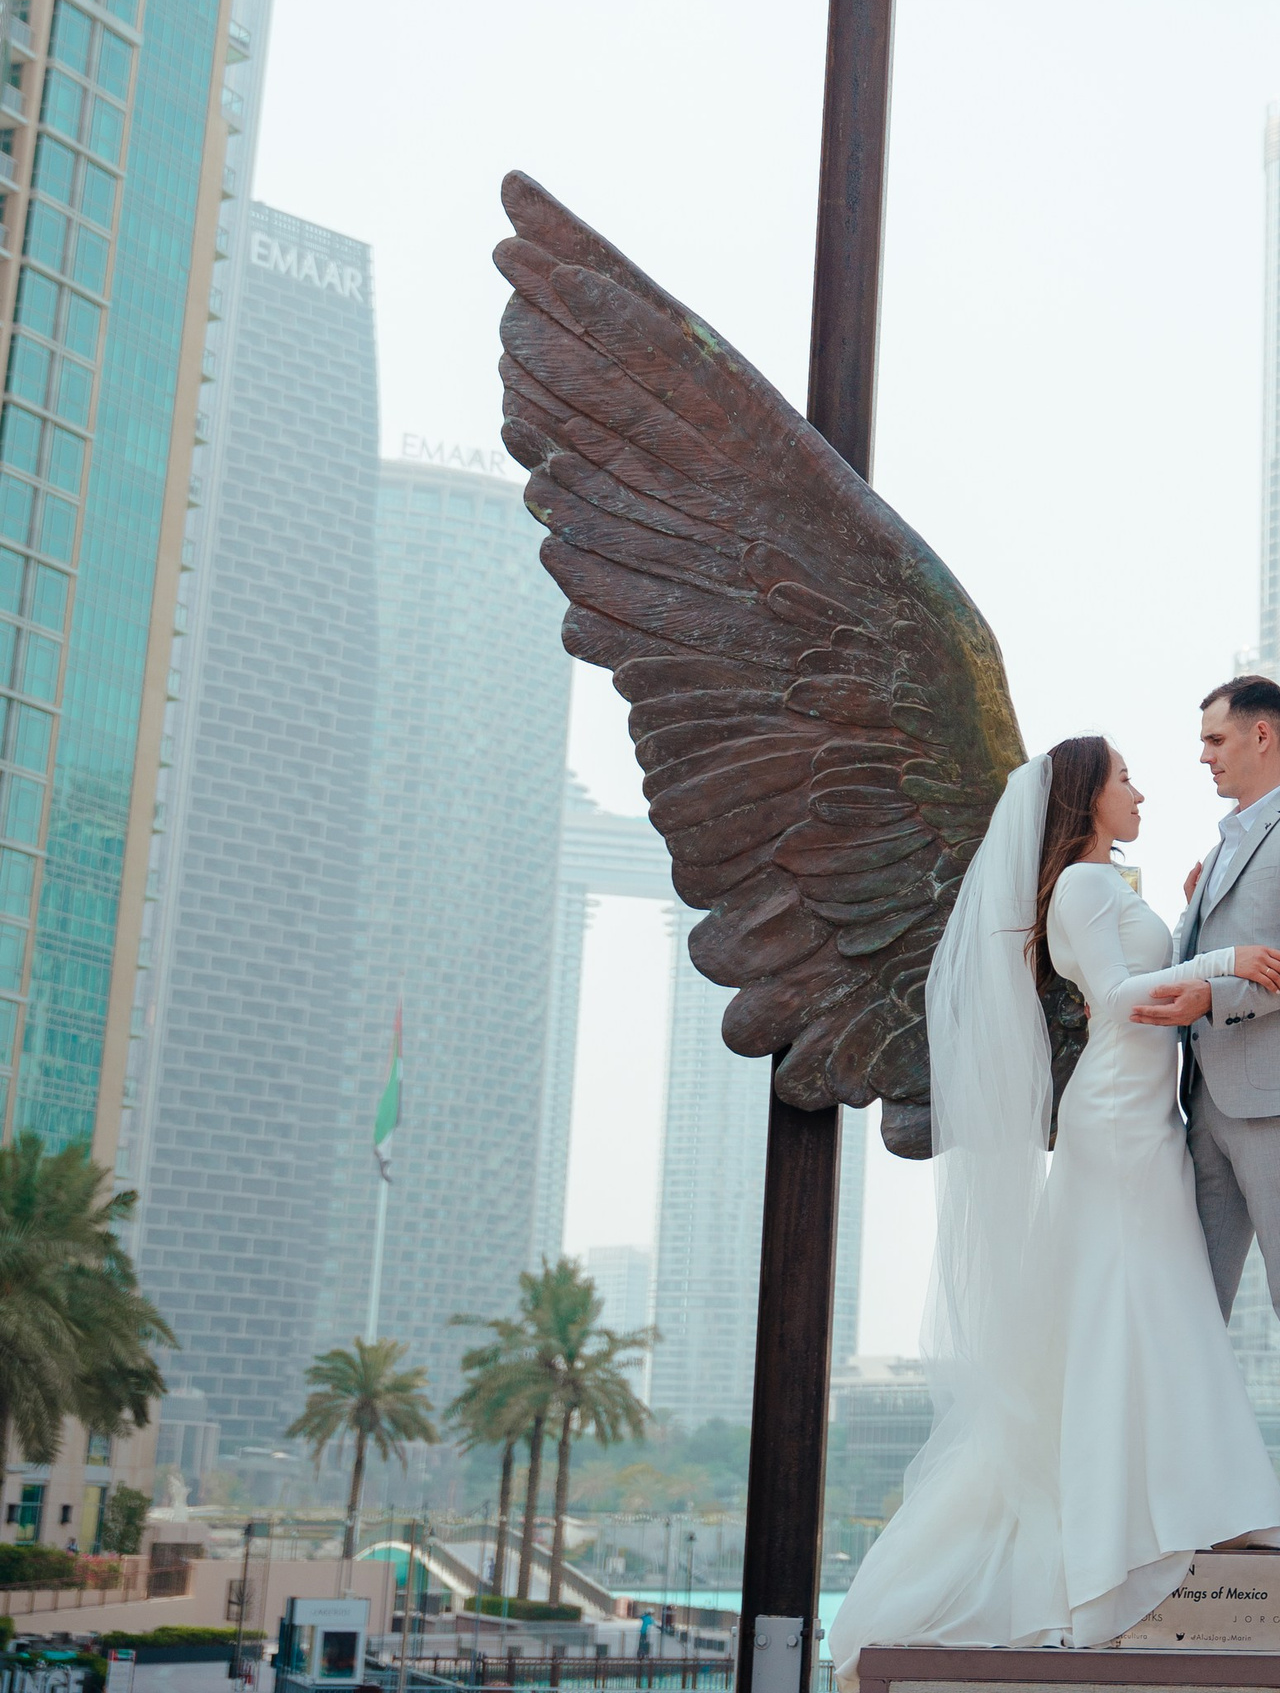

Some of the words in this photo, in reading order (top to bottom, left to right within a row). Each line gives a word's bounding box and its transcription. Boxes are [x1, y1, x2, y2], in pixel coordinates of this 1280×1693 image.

[251, 234, 364, 303] EMAAR
[402, 432, 506, 476] EMAAR
[1171, 1587, 1207, 1603] Wings
[1211, 1586, 1224, 1599] of
[1226, 1587, 1268, 1601] Mexico
